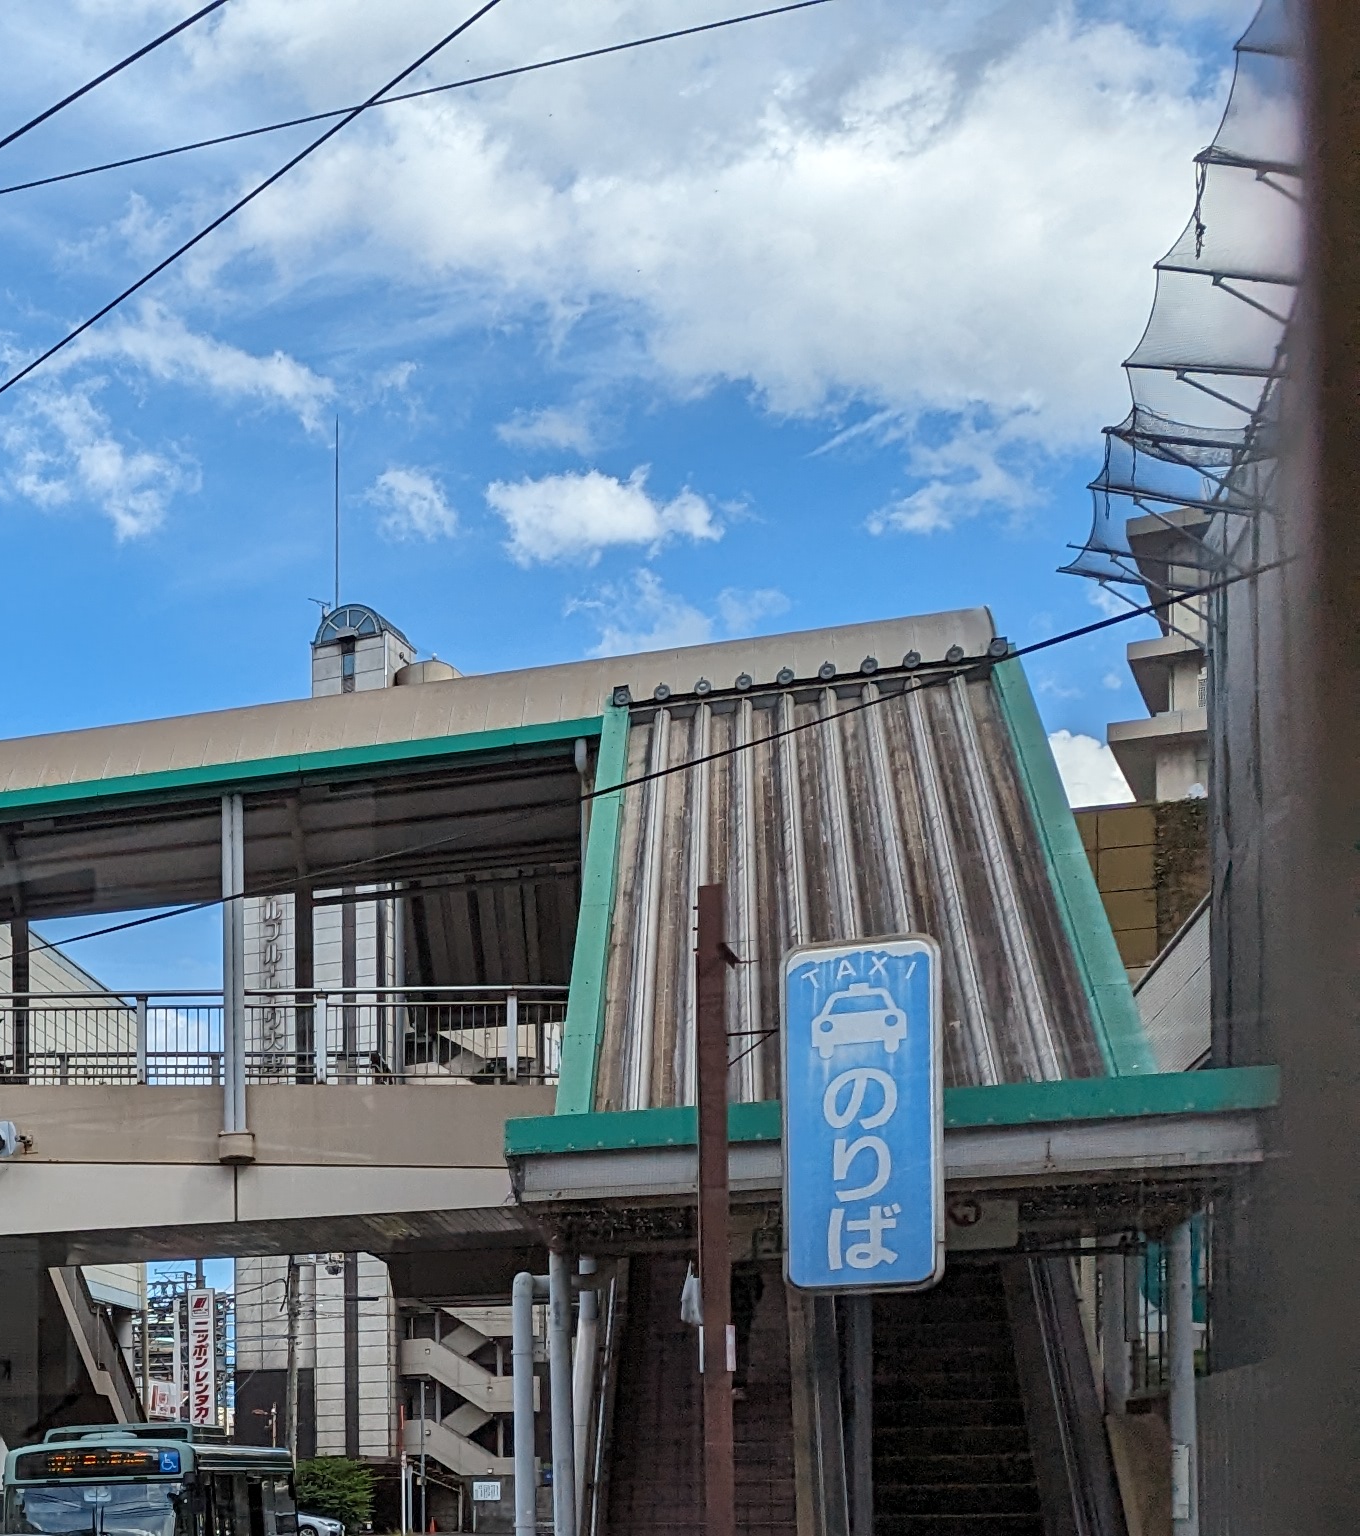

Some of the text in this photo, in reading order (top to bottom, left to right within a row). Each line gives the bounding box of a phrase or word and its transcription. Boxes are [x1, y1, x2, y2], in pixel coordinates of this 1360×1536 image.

[265, 897, 284, 1074] ルブルーレーク大津
[800, 955, 917, 990] TAXI
[823, 1067, 902, 1271] のりば
